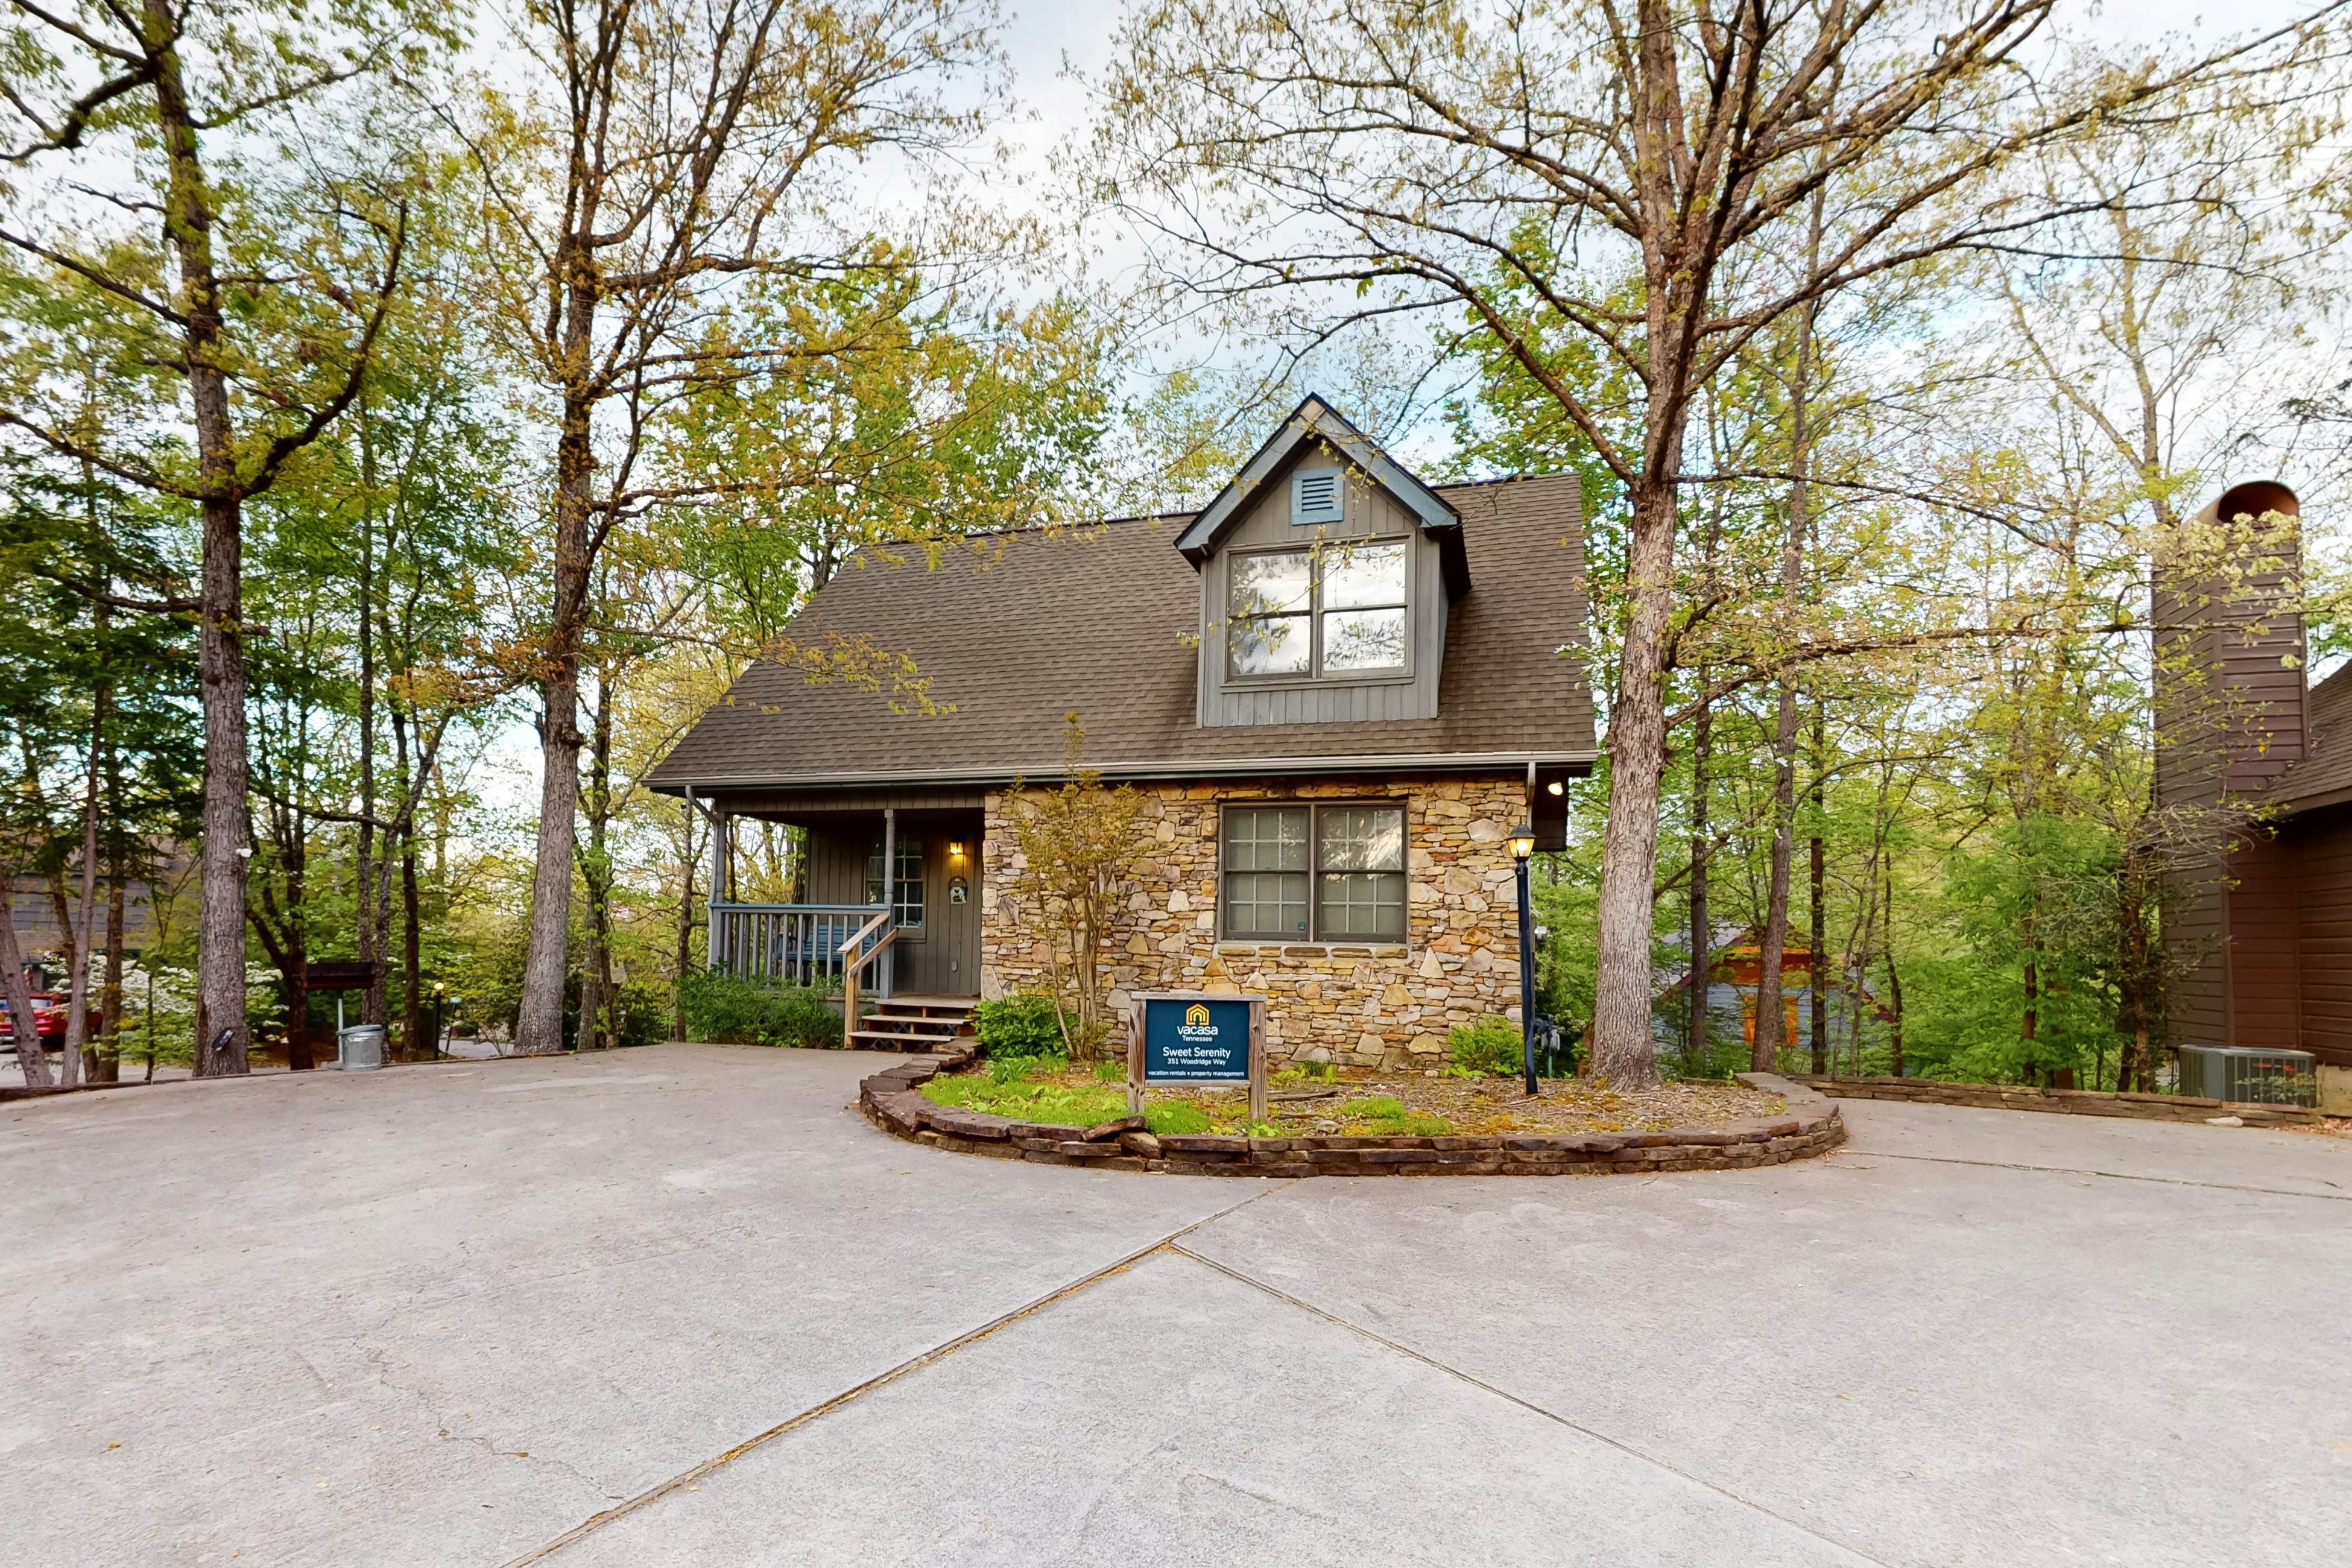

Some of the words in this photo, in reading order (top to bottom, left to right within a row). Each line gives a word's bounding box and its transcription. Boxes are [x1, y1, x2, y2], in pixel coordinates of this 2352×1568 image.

[1177, 1025, 1218, 1035] vacasa
[1163, 1046, 1192, 1057] Sweet
[1193, 1047, 1231, 1059] Serenity
